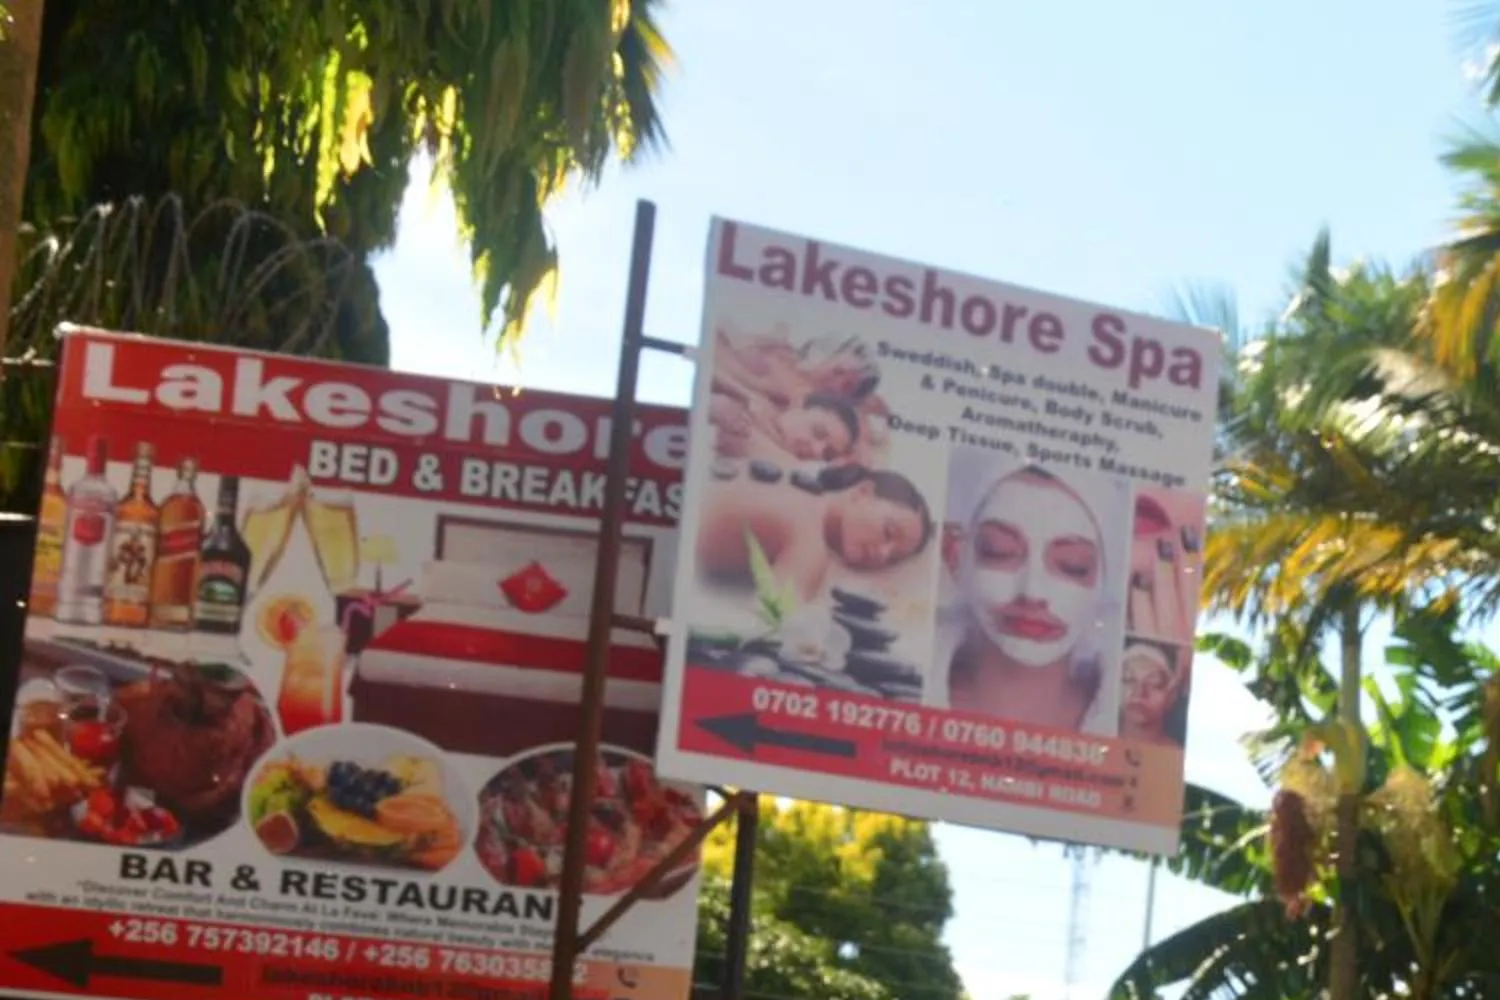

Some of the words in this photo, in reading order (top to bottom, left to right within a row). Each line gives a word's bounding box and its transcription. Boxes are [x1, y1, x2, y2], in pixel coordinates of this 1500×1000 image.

[715, 219, 1065, 355] Lakeshore
[1086, 313, 1204, 390] Spa
[81, 341, 689, 469] Lakeshore
[988, 363, 1026, 386] Spa
[1112, 388, 1204, 423] Manicure
[1045, 397, 1095, 427] Body
[308, 439, 400, 488] BED
[412, 450, 445, 493] &
[887, 414, 941, 442] Deep
[1026, 441, 1093, 470] Sports
[1099, 455, 1187, 489] Massage
[751, 685, 819, 720] 0702
[827, 699, 922, 736] 192776
[888, 756, 942, 784] PLOT
[118, 852, 213, 888] BAR
[230, 863, 260, 892] &
[280, 868, 583, 922] RESTAURAN
[108, 919, 178, 946] +256
[187, 924, 340, 963] 757392146
[364, 942, 431, 970] +256
